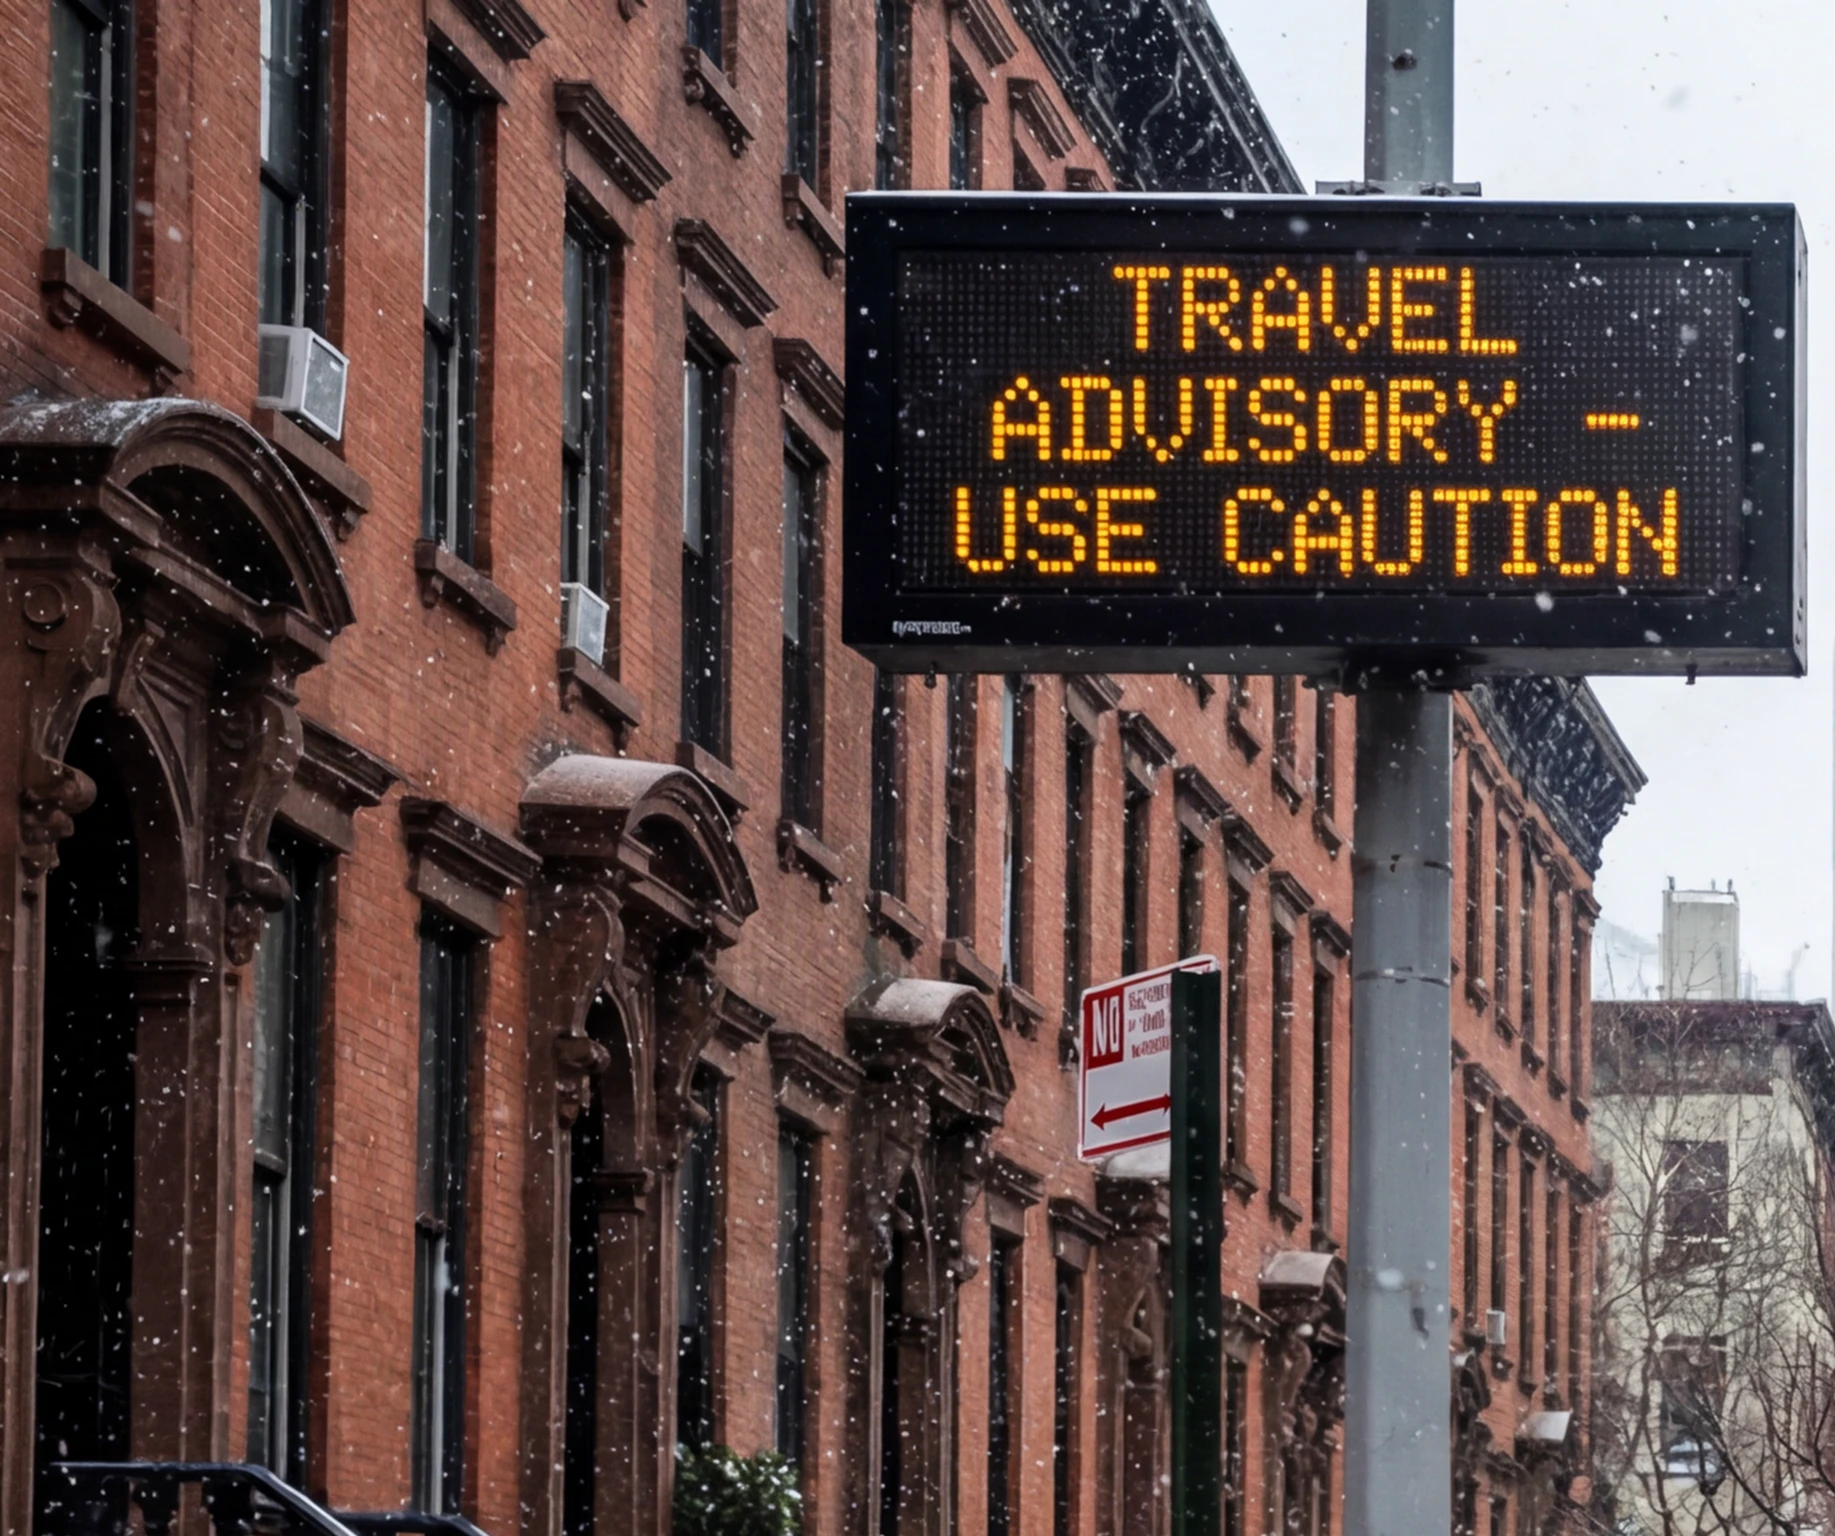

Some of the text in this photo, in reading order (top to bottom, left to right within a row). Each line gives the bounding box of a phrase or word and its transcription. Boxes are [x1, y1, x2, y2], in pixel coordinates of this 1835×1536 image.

[1112, 265, 1518, 355] TRAVEL
[990, 375, 1518, 464] ADVISORY
[954, 486, 1679, 579] USE CAUTION
[1092, 995, 1120, 1058] NO
